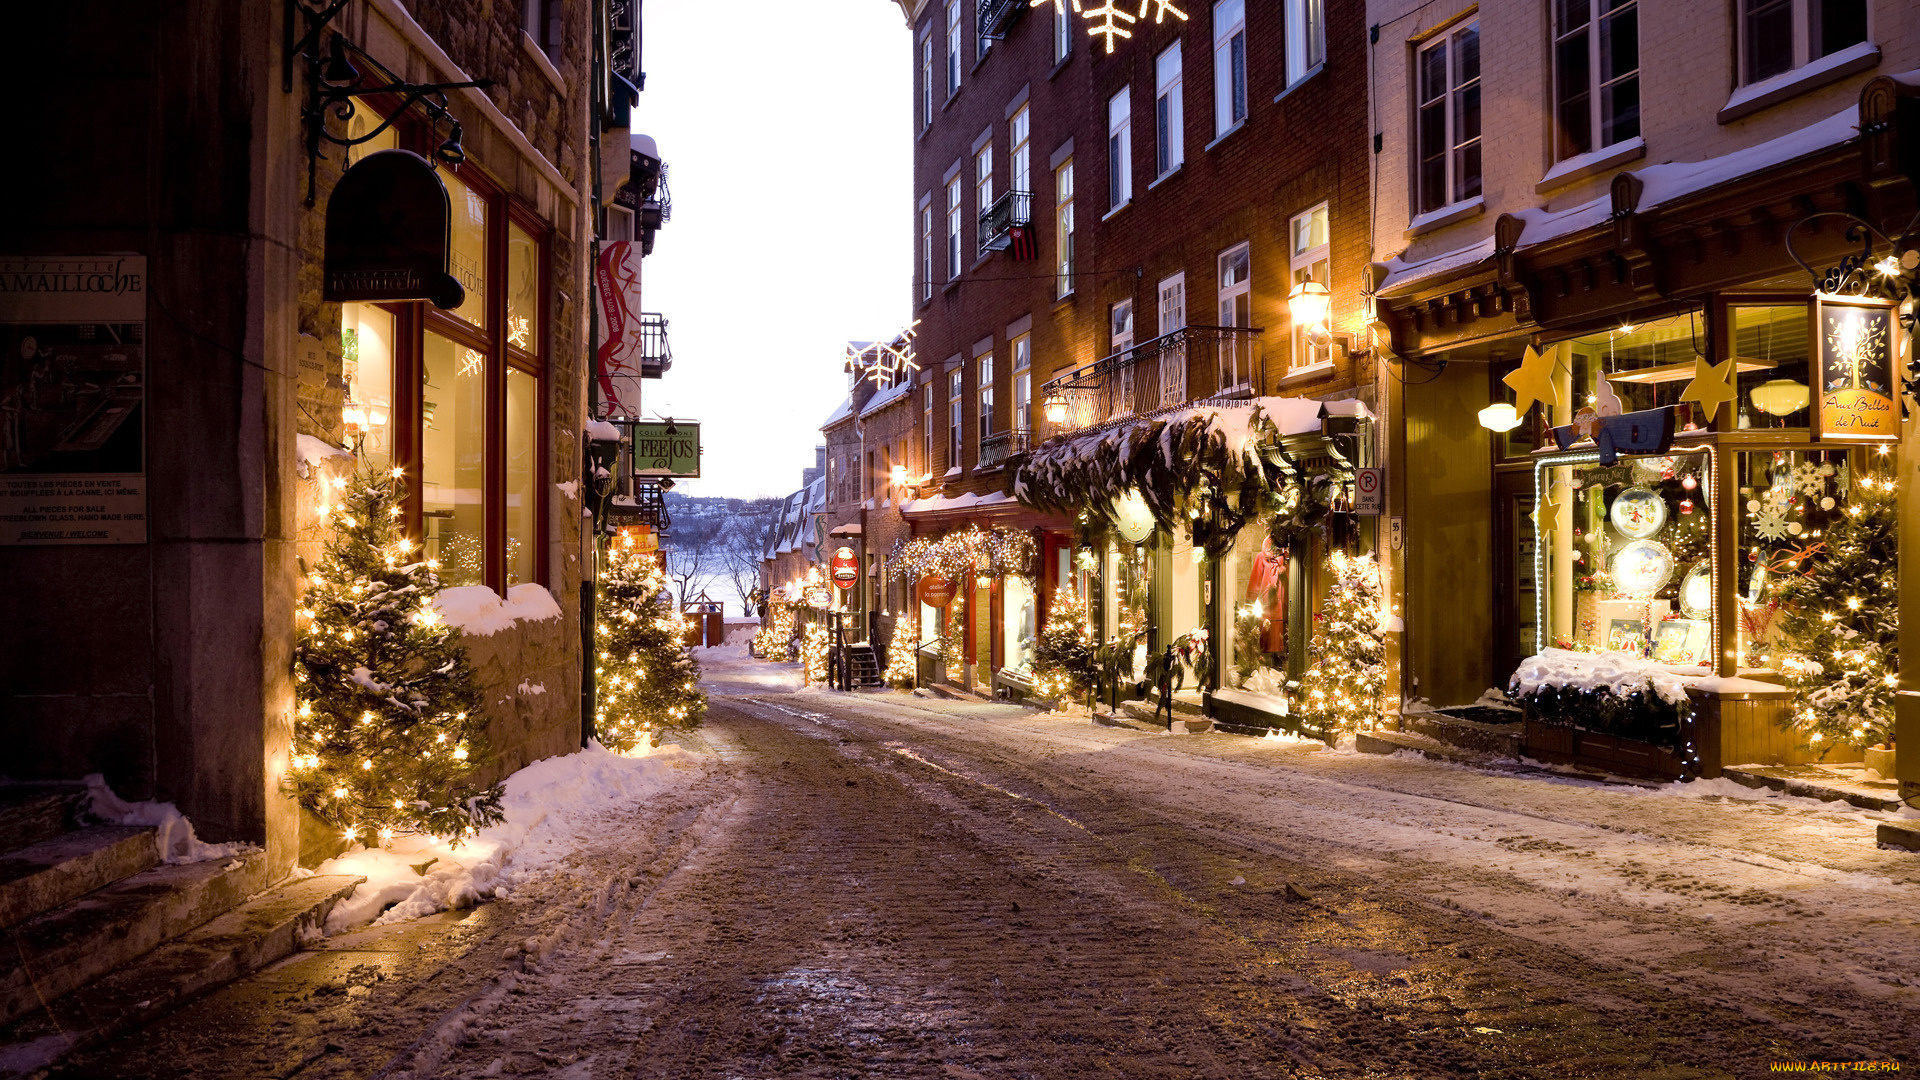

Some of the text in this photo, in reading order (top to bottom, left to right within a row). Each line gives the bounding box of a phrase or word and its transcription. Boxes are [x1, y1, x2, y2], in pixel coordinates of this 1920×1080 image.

[600, 269, 611, 297] QUÉBEC
[1823, 395, 1890, 412] Aux Belles
[1835, 413, 1880, 428] de Nuit
[7, 481, 37, 489] TOUTES
[84, 480, 95, 488] EN
[104, 488, 114, 496] ICI
[70, 530, 109, 538] WELCOME
